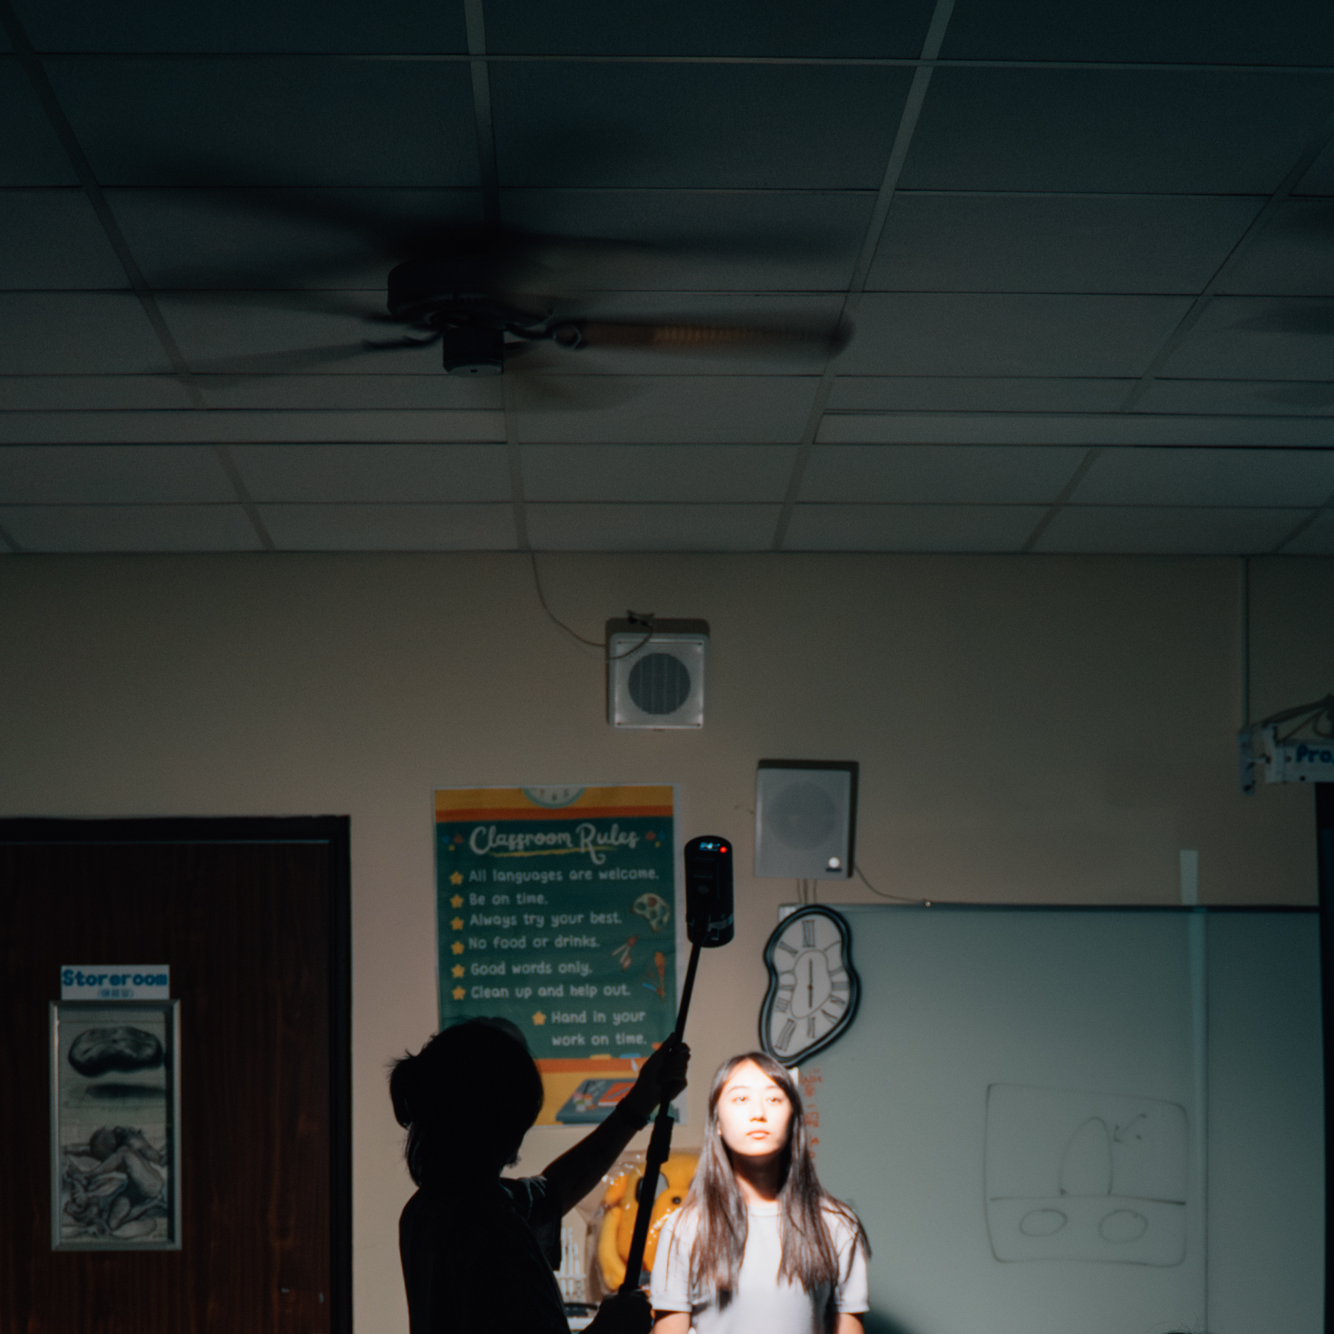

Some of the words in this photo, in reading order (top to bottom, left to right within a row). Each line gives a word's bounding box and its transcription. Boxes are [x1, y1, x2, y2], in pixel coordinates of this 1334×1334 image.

[469, 825, 573, 855] Classroom
[575, 823, 640, 865] Rules
[469, 870, 486, 882] All
[493, 869, 563, 884] languages
[569, 870, 592, 880] are
[599, 868, 659, 880] welcome.
[469, 893, 485, 906] Be
[492, 894, 510, 905] on
[517, 893, 548, 905] time.
[470, 914, 517, 927] Always
[523, 914, 544, 928] try
[551, 914, 584, 927] your
[590, 912, 622, 924] best.
[468, 937, 487, 949] No
[493, 936, 526, 949] food
[533, 938, 549, 948] or
[555, 935, 599, 948] drinks.
[471, 961, 506, 975] Good
[512, 961, 552, 974] words
[558, 961, 593, 977] only.
[63, 970, 166, 985] Storeroom
[471, 986, 509, 999] Clean
[515, 987, 532, 999] up
[538, 985, 564, 997] and
[570, 985, 598, 998] help
[603, 984, 631, 996] out.
[551, 1010, 587, 1023] Hand
[593, 1011, 606, 1022] in
[613, 1011, 646, 1025] your
[552, 1034, 585, 1046] work
[591, 1035, 609, 1046] on
[616, 1033, 647, 1045] time.
